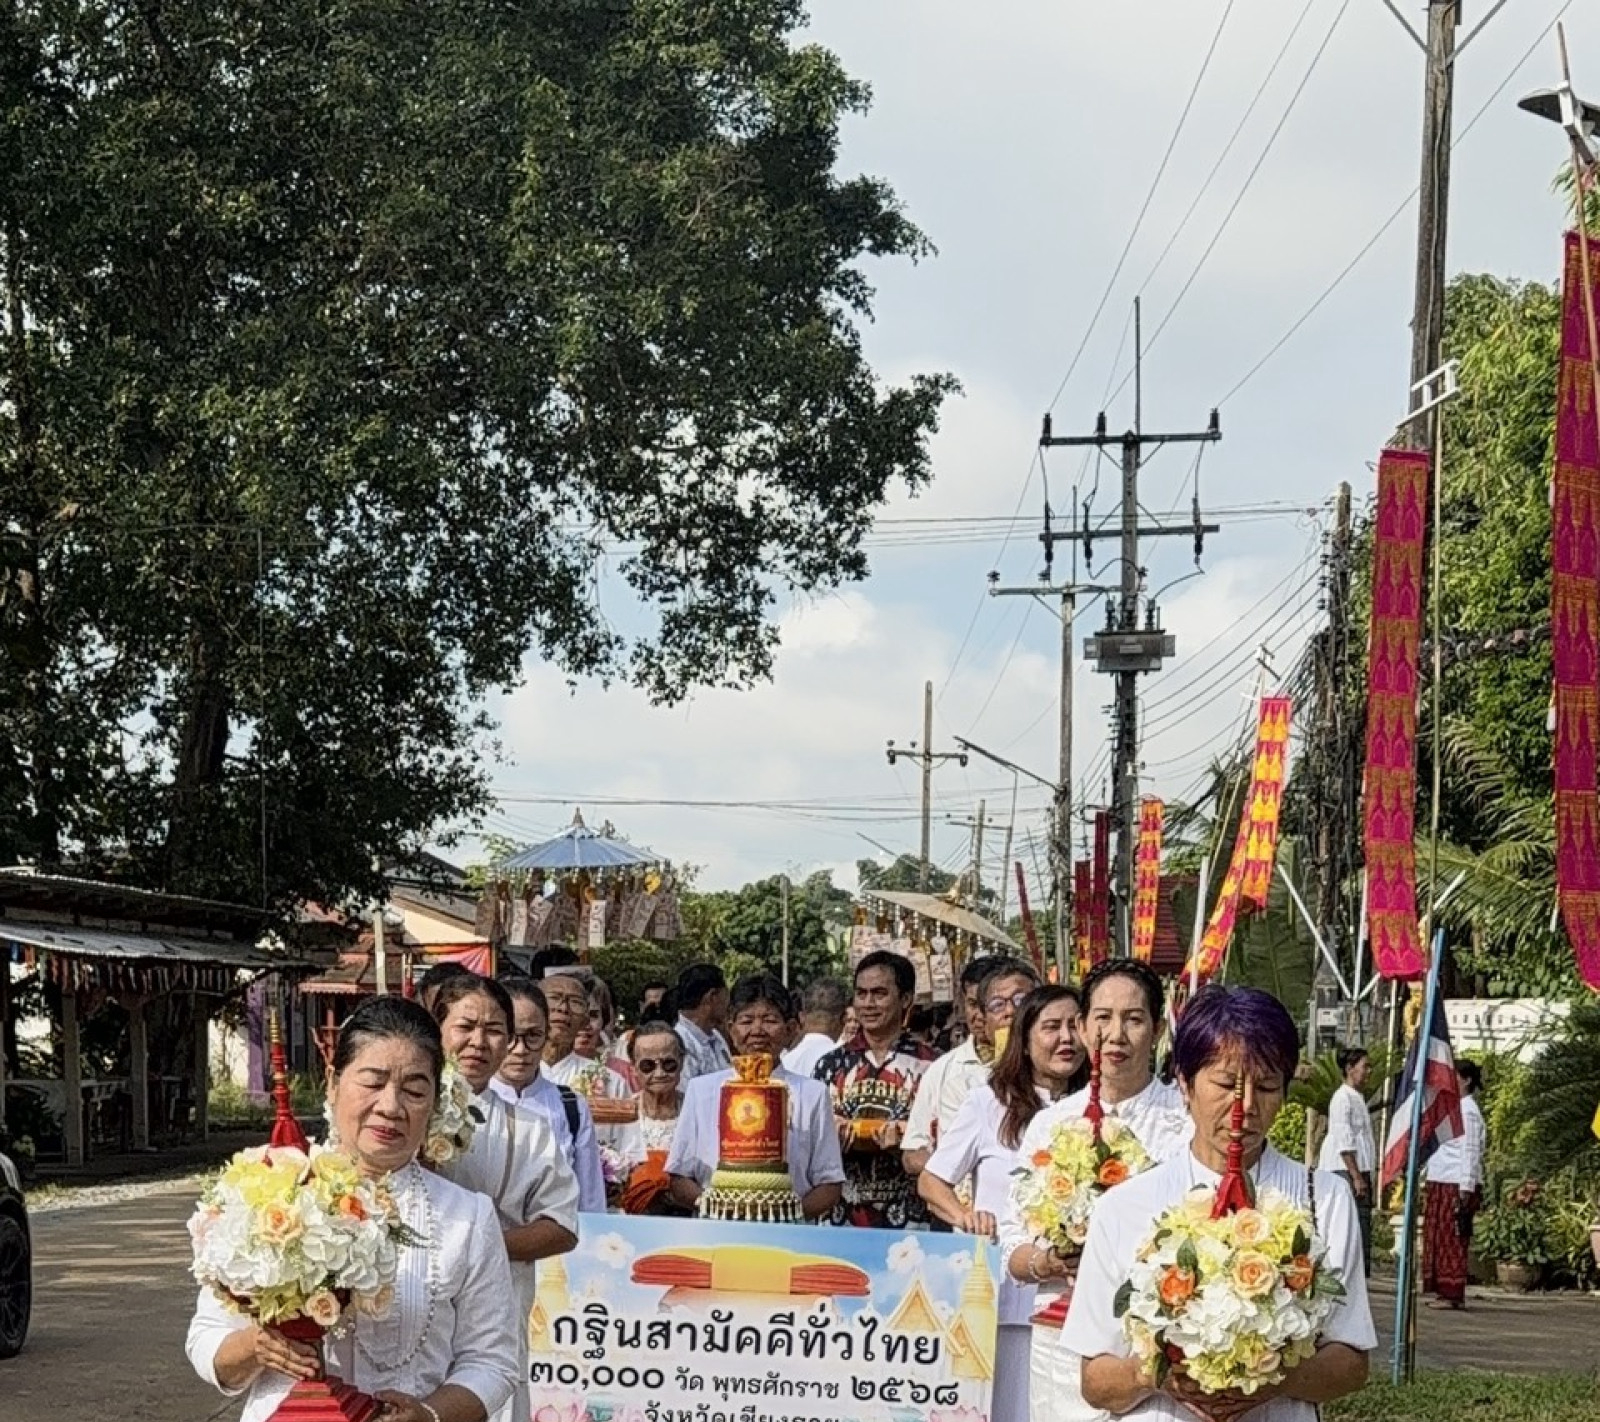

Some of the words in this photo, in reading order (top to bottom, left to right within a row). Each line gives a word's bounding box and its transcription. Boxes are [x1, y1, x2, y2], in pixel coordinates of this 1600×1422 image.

[553, 1303, 940, 1365] กฐินสามัคคีทั่วไทย
[530, 1361, 665, 1391] ๓๐,๐๐๐
[675, 1366, 704, 1391] วัด
[712, 1371, 839, 1402] พุทธศักราช
[851, 1375, 959, 1405] ๒๕๖๘
